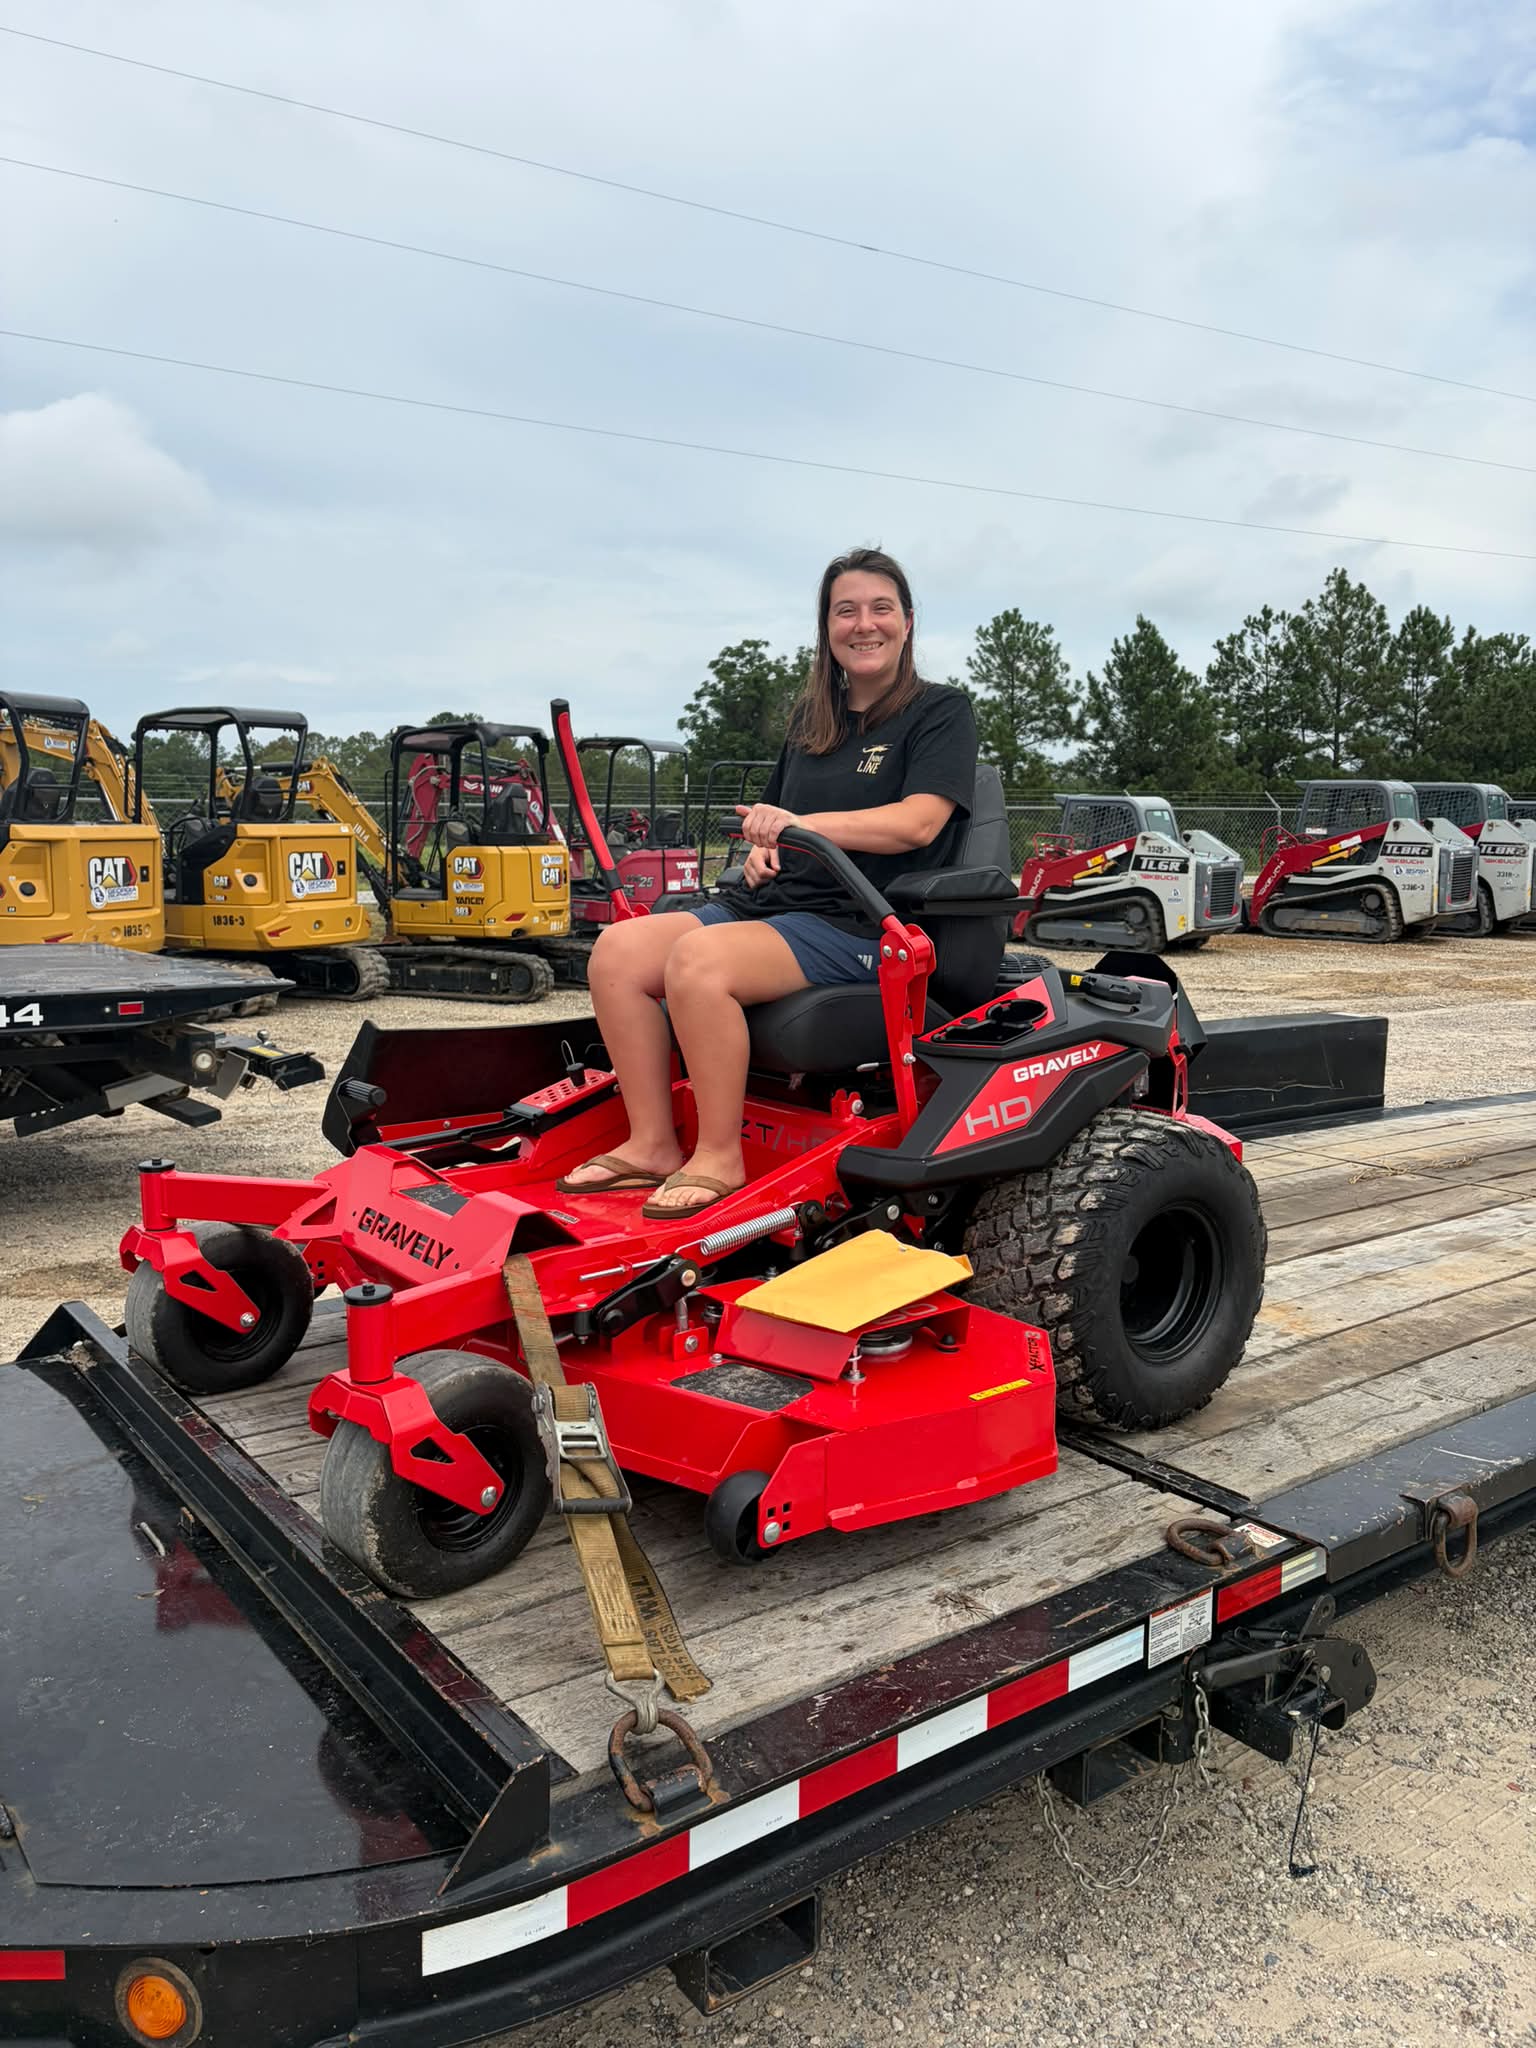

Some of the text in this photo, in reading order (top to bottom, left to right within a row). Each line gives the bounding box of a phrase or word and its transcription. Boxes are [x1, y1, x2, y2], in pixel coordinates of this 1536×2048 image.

[89, 857, 126, 887] CAT
[288, 852, 324, 881] CAT
[454, 856, 477, 874] CAT
[1140, 857, 1184, 872] TL6R
[213, 875, 228, 887] CAT
[542, 867, 561, 885] CAT
[212, 915, 246, 926] 1836-3
[123, 924, 143, 937] 1835
[1013, 1043, 1102, 1083] GRAVELY
[964, 1095, 1033, 1137] HD
[357, 1206, 455, 1270] GRAVELY
